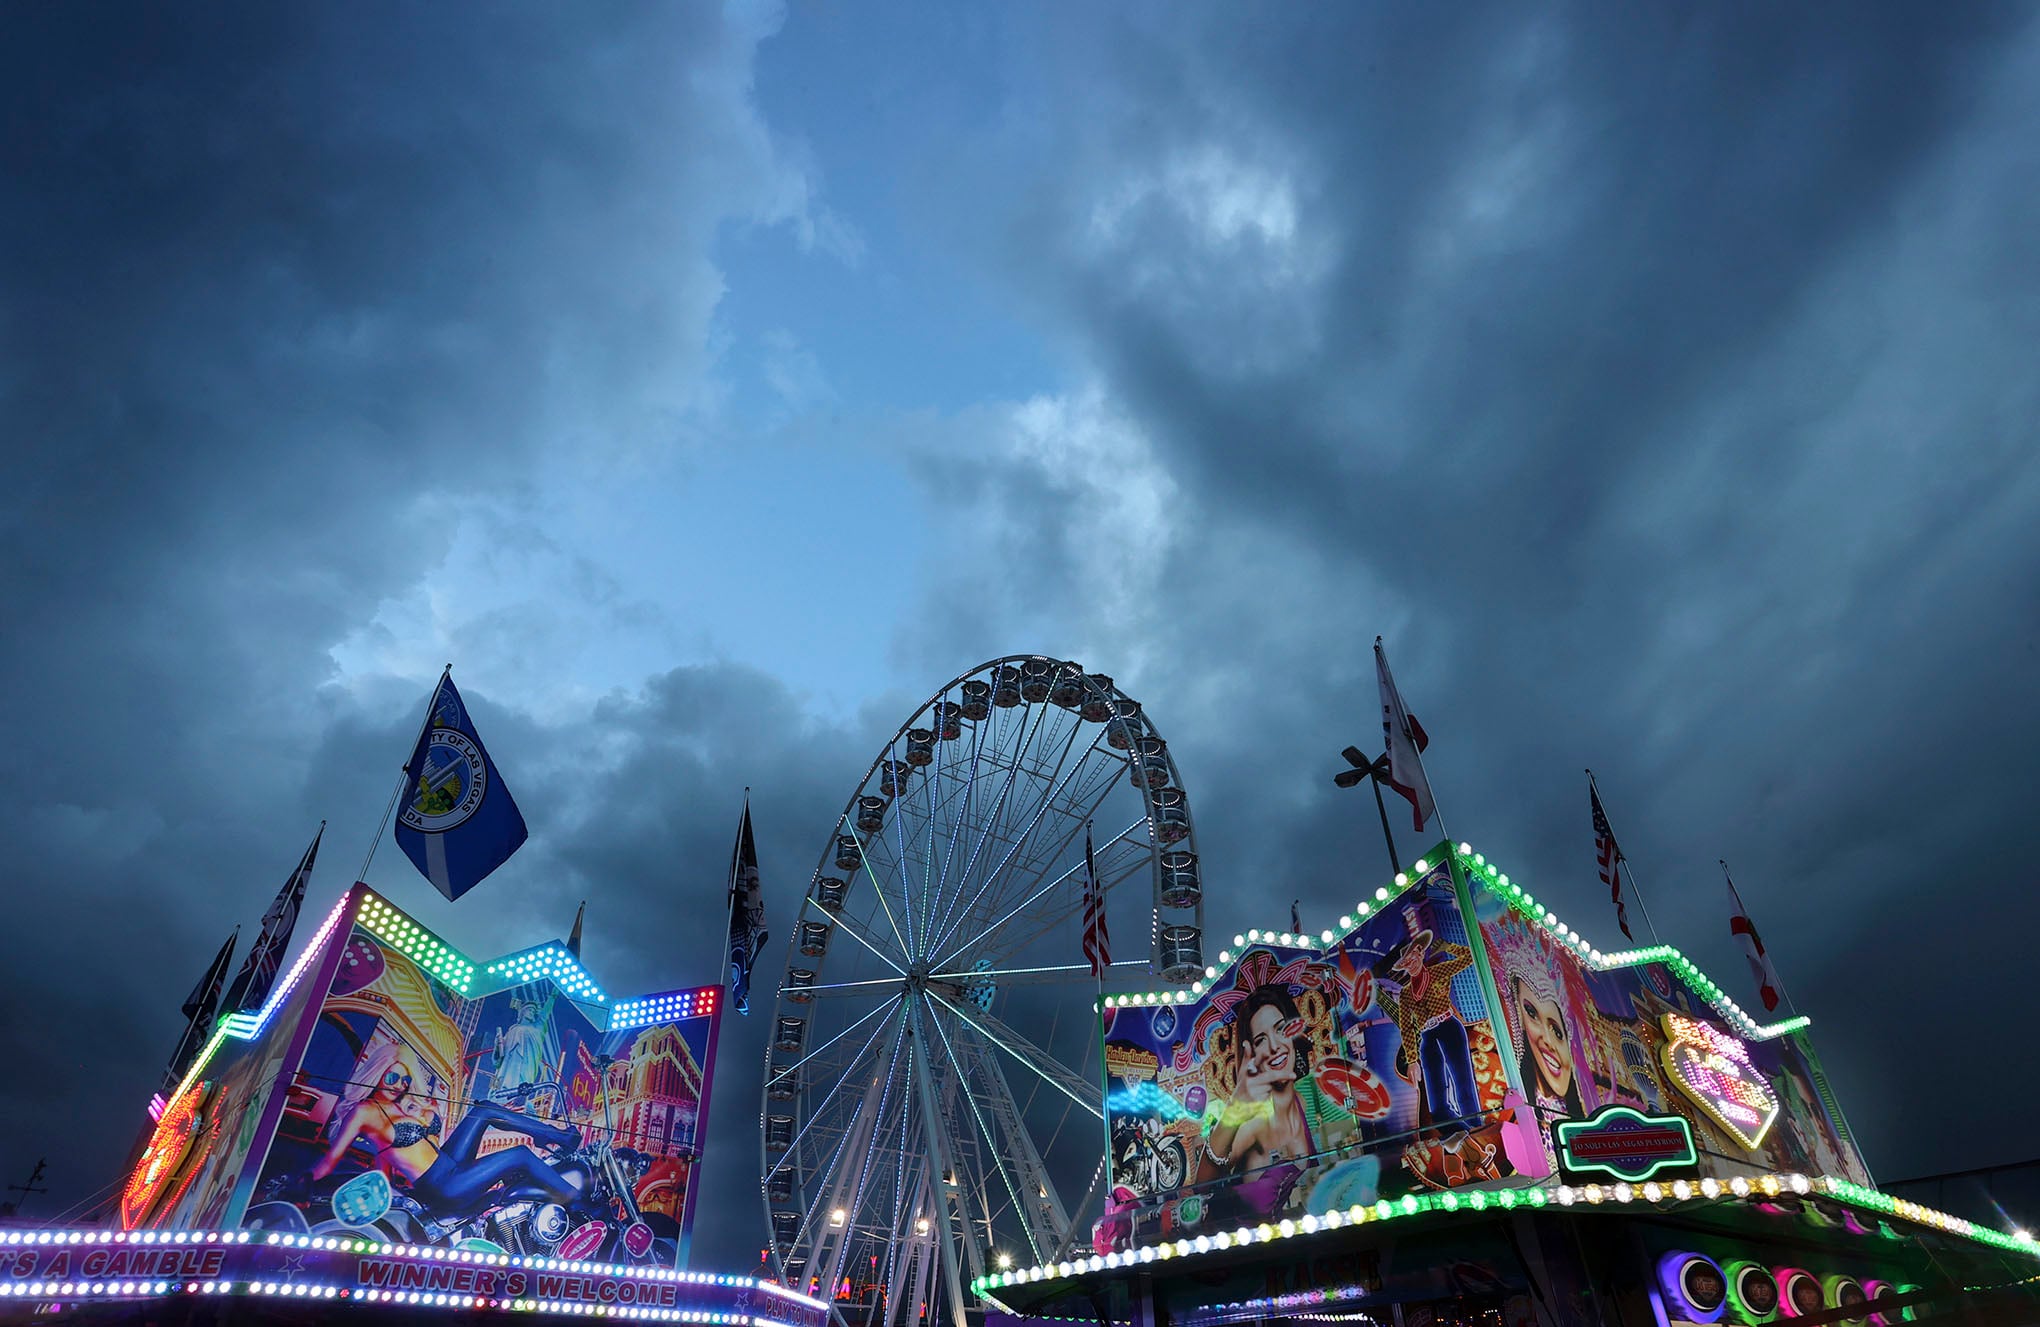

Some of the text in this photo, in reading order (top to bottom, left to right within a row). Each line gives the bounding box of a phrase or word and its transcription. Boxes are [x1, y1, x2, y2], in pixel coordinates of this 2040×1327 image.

[431, 733, 445, 742] TY
[448, 735, 465, 746] OF
[463, 746, 480, 768] LAS
[462, 772, 482, 812] VEGAS
[1622, 1139, 1645, 1149] VEGAS
[42, 1250, 71, 1279] A
[82, 1249, 225, 1279] GAMBLE
[537, 1274, 677, 1307] WELCOME
[765, 1296, 820, 1327] PLAY TO WIN
